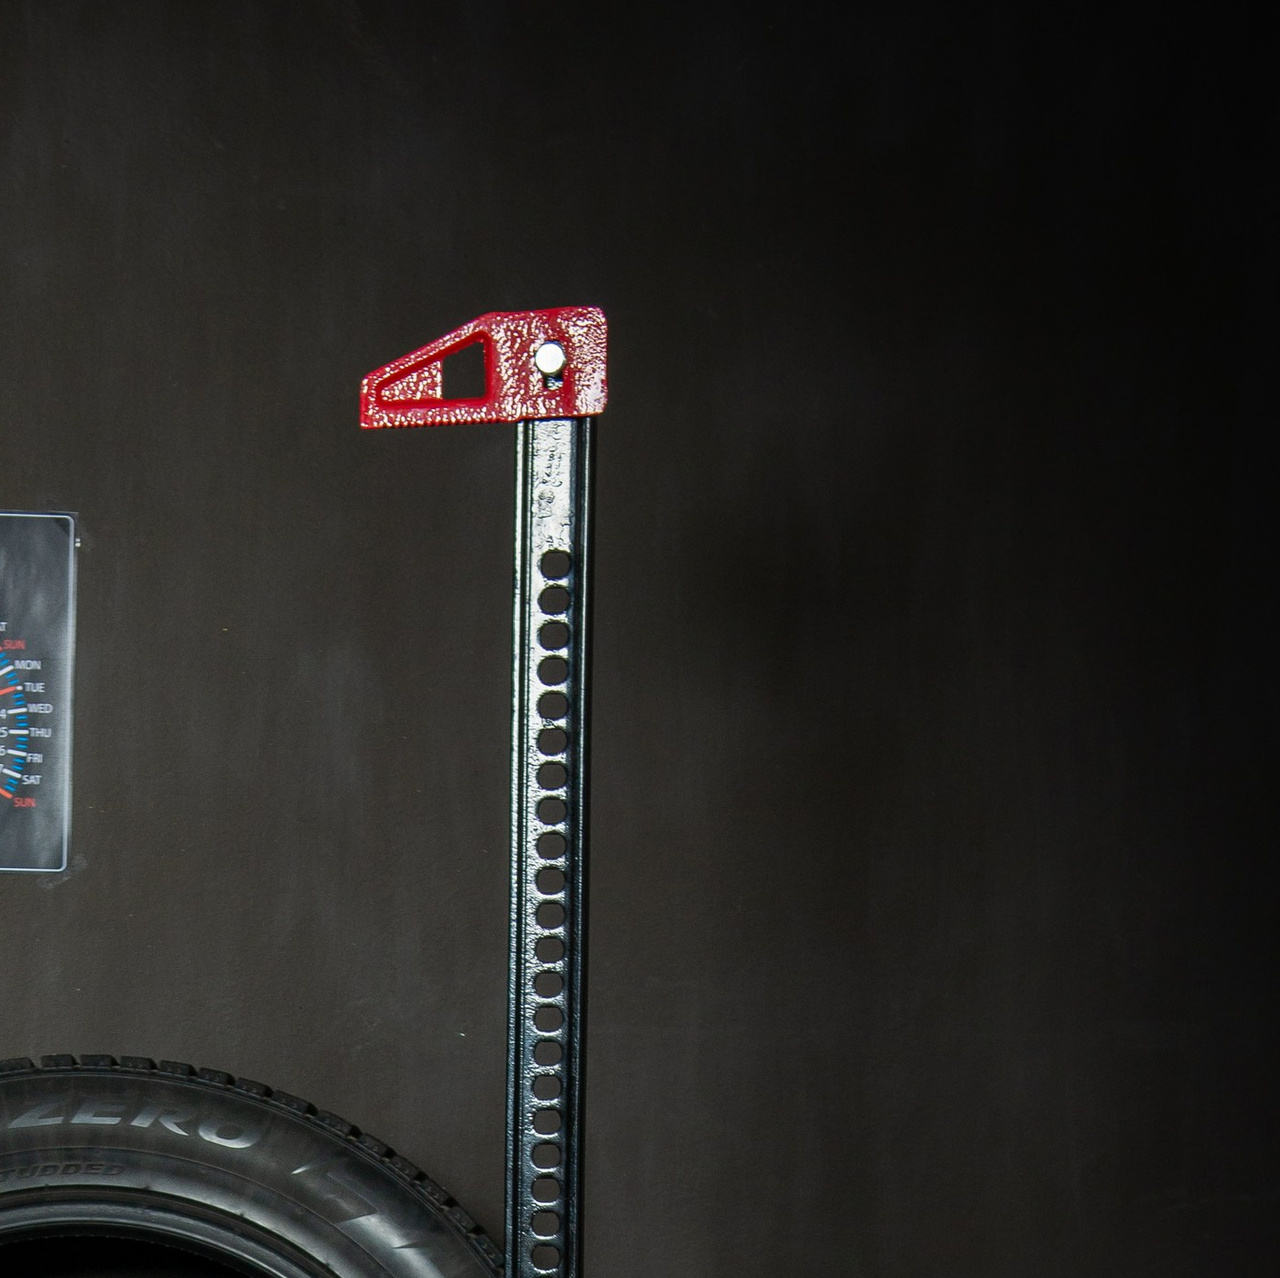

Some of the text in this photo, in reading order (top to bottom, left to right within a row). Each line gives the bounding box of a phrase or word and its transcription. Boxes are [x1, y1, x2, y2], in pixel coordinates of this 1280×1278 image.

[3, 639, 26, 650] SUN
[14, 660, 41, 670] MON
[23, 682, 46, 693] TUE
[27, 703, 53, 713] WED
[29, 727, 52, 738] THU
[26, 753, 43, 763] FRI
[22, 775, 42, 785] SAT
[14, 797, 36, 808] SUN
[6, 1099, 262, 1150] ZERO
